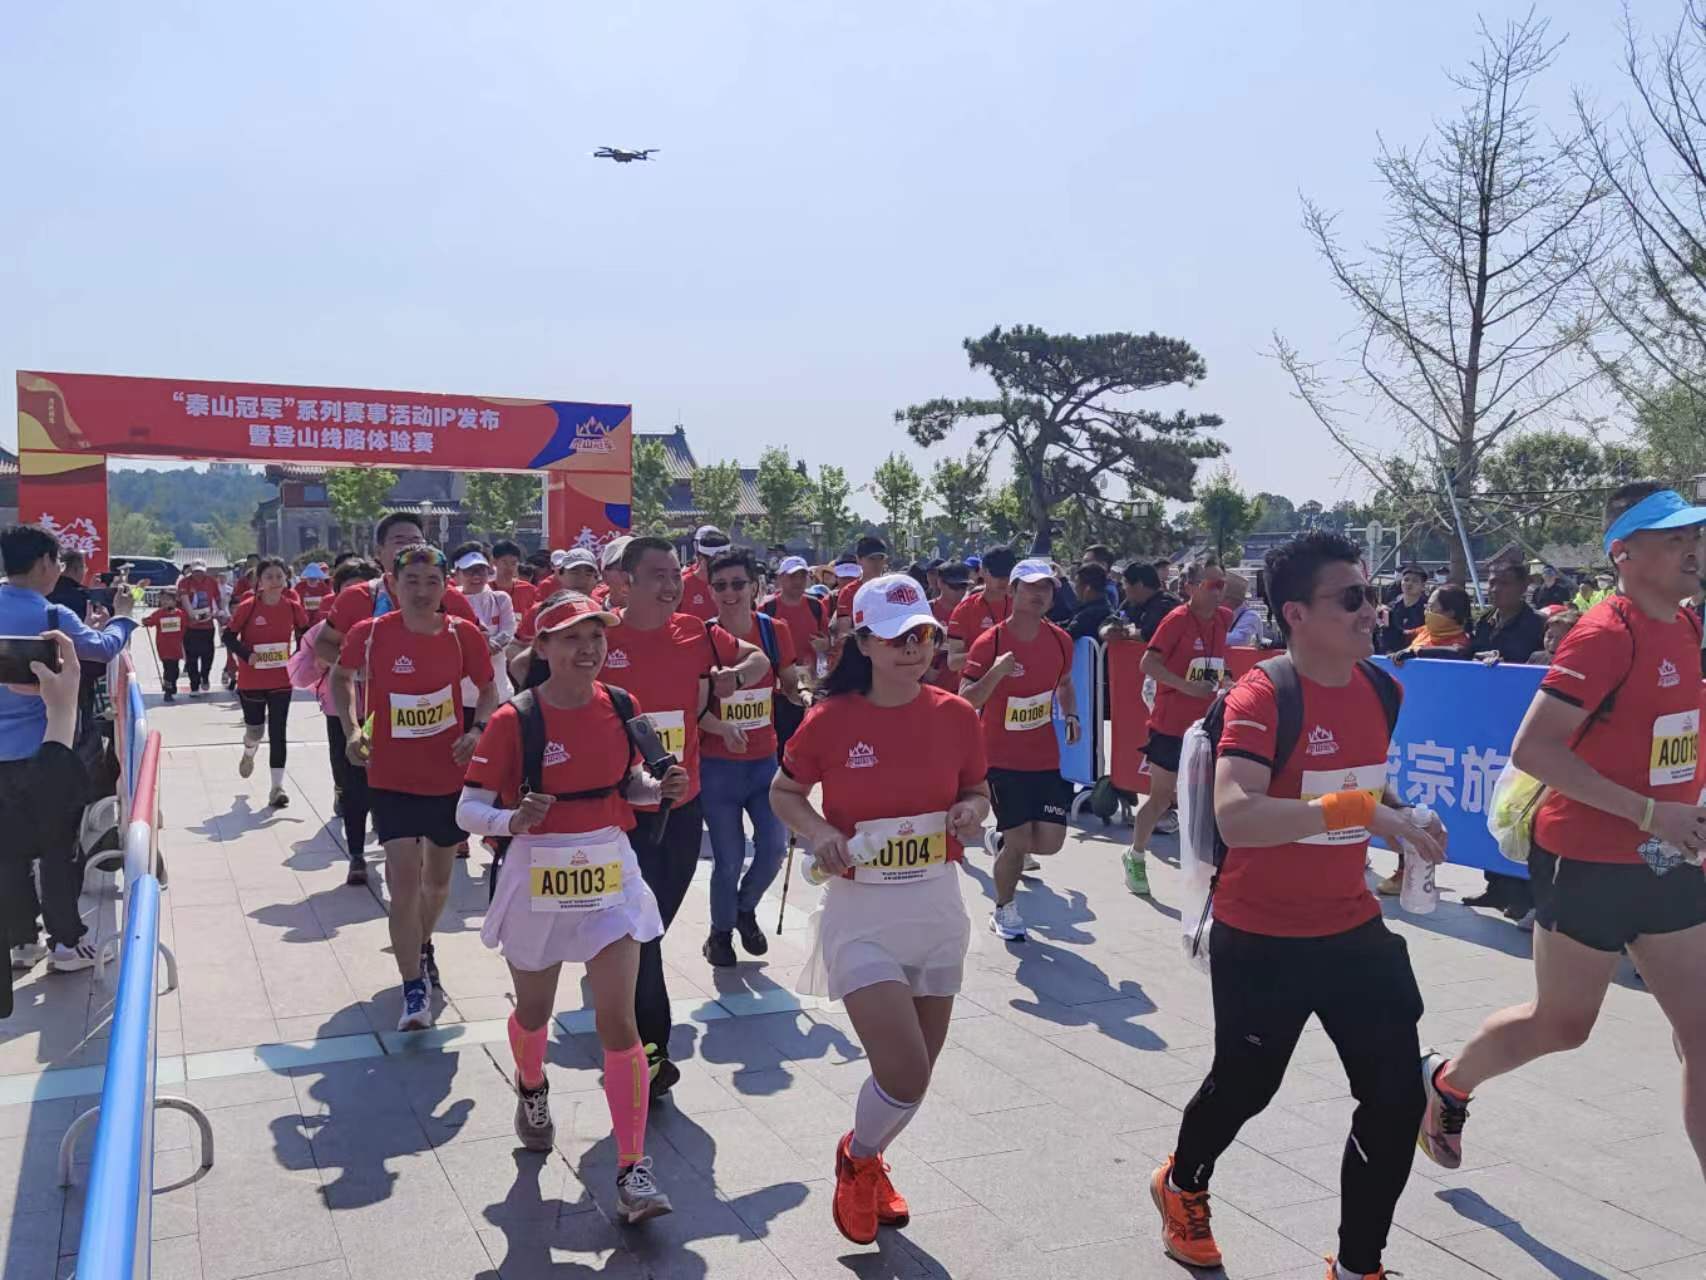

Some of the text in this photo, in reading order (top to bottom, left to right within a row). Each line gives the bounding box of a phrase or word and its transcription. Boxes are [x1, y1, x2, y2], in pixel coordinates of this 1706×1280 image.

[249, 424, 434, 454] 暨登山线路体验赛
[397, 704, 444, 727] A0027
[726, 702, 764, 720] A0010
[1010, 704, 1044, 722] A0108
[1387, 739, 1512, 817] 宗旅
[864, 837, 930, 867] 0104
[541, 867, 606, 896] A0103
